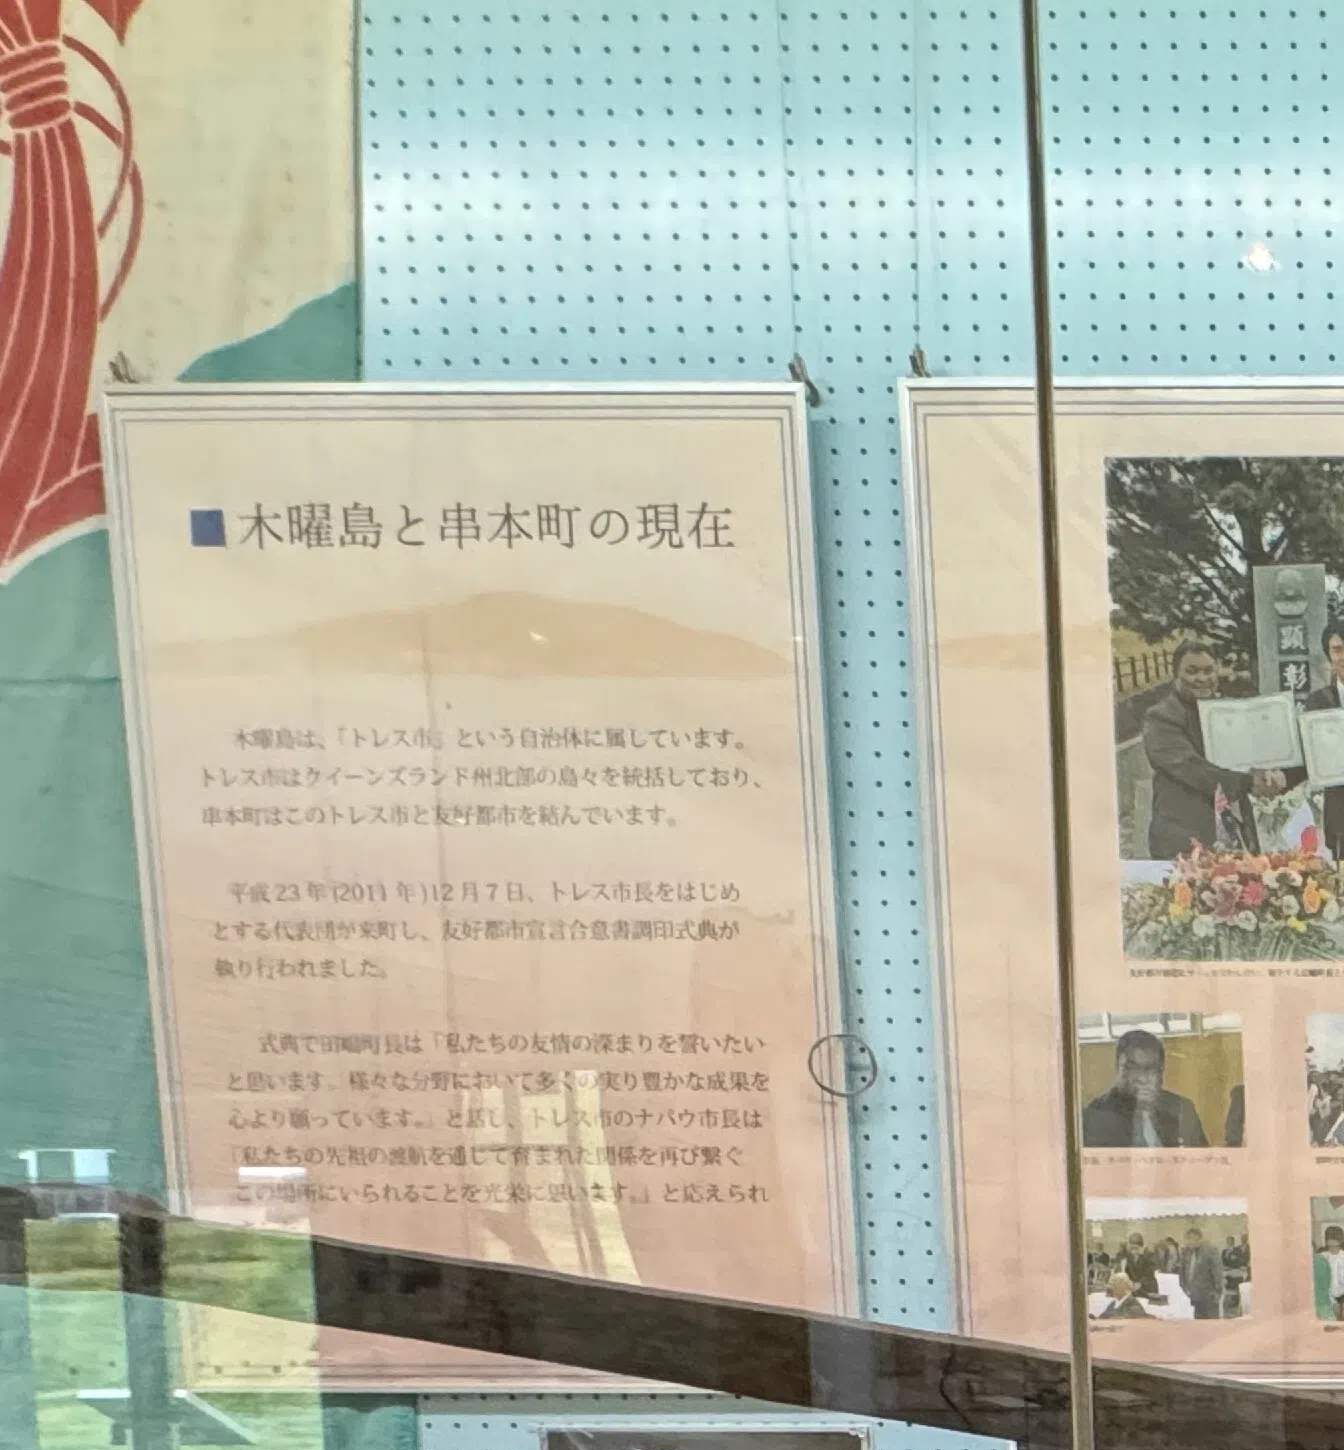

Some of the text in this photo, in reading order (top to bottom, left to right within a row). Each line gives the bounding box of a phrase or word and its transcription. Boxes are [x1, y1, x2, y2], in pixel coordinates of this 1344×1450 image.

[237, 501, 736, 551] 木曜島と串本町の現在
